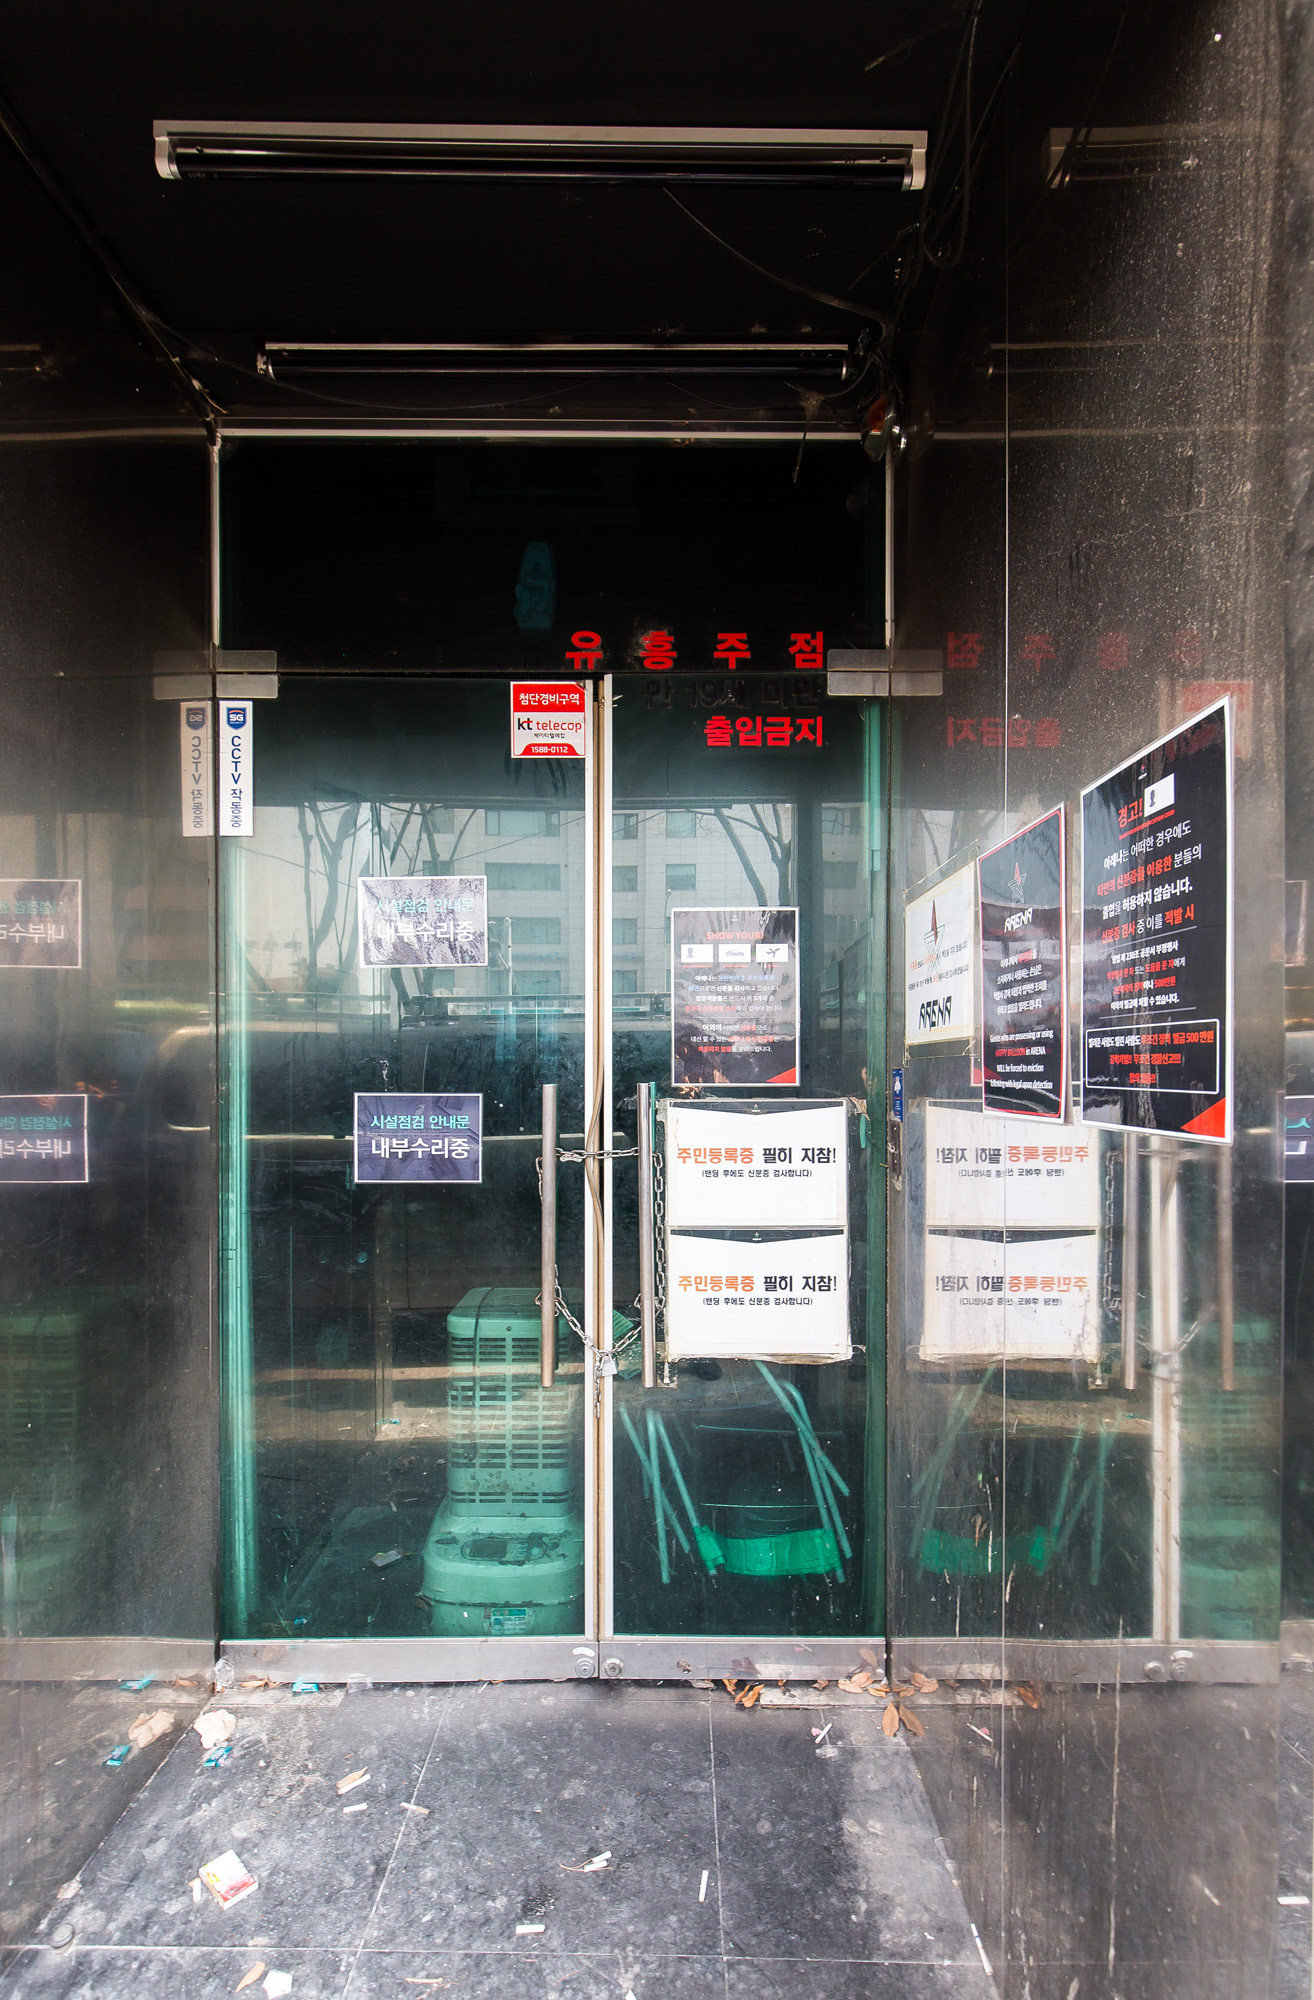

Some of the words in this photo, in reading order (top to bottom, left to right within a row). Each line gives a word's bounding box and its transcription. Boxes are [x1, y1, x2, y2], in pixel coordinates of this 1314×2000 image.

[519, 693, 580, 706] 첨단경비구역
[644, 679, 674, 709] 만
[762, 679, 821, 709] 미만
[229, 714, 244, 722] SG
[518, 718, 533, 730] kt
[536, 720, 582, 733] telecop
[704, 716, 823, 747] 출입금지
[231, 736, 242, 784] CCTV
[230, 788, 243, 828] 작동중
[1118, 798, 1143, 828] 경고!
[1104, 848, 1129, 870] 아레나는
[1130, 837, 1154, 857] 어떠한
[1156, 820, 1191, 847] 경우에도
[1097, 878, 1115, 896] 타인의
[1116, 866, 1145, 889] 신분증을
[1147, 855, 1172, 877] 이용한
[1174, 844, 1202, 868] 분들의
[378, 898, 429, 913] 시설점검
[434, 898, 475, 912] 안내문
[1102, 901, 1121, 920] 출입을
[1122, 889, 1152, 911] 허용하지
[1154, 877, 1193, 902] 않습니다.
[1004, 907, 1033, 933] ARENA
[1102, 928, 1120, 944] 신분증
[1121, 921, 1136, 938] 검사
[1137, 919, 1145, 934] 중
[1146, 913, 1162, 930] 이를
[1164, 907, 1183, 925] 적발
[1184, 904, 1194, 920] 시
[378, 921, 474, 942] 내부수리중
[706, 932, 734, 940] SHOW
[735, 932, 764, 940] YOUR!
[1140, 946, 1155, 958] 공문서
[1156, 940, 1179, 953] 부정행사
[1135, 966, 1144, 975] 또는
[1145, 962, 1160, 973] 도움을
[1162, 960, 1167, 970] 준
[1168, 956, 1186, 968] 자에게
[1154, 976, 1176, 988] 500만원
[1124, 999, 1138, 1009] 벌금에
[1149, 997, 1155, 1006] 수
[1156, 992, 1180, 1005] 있습니다.
[919, 996, 952, 1031] ARENA
[1041, 1029, 1054, 1038] using
[1173, 1032, 1186, 1044] 벌금
[1186, 1032, 1199, 1043] 500
[1200, 1030, 1214, 1043] 만원
[1030, 1046, 1046, 1055] ARENA
[370, 1115, 424, 1130] 시설점검
[429, 1115, 470, 1130] 안내문
[371, 1138, 470, 1159] 내부수리중
[677, 1148, 754, 1164] 주민등록증
[762, 1147, 792, 1164] 필히
[801, 1147, 837, 1164] 지참!
[702, 1169, 719, 1178] (밴딩
[723, 1169, 744, 1178] 후에도
[748, 1169, 769, 1178] 신분증
[773, 1169, 812, 1178] 검사합니다)
[678, 1276, 755, 1292] 주민등록증
[764, 1276, 793, 1292] 필히
[802, 1276, 837, 1292] 지참!
[703, 1298, 720, 1306] (밴딩
[724, 1298, 745, 1306] 후에도
[748, 1298, 770, 1306] 신분증
[774, 1298, 813, 1306] 검사합니다)
